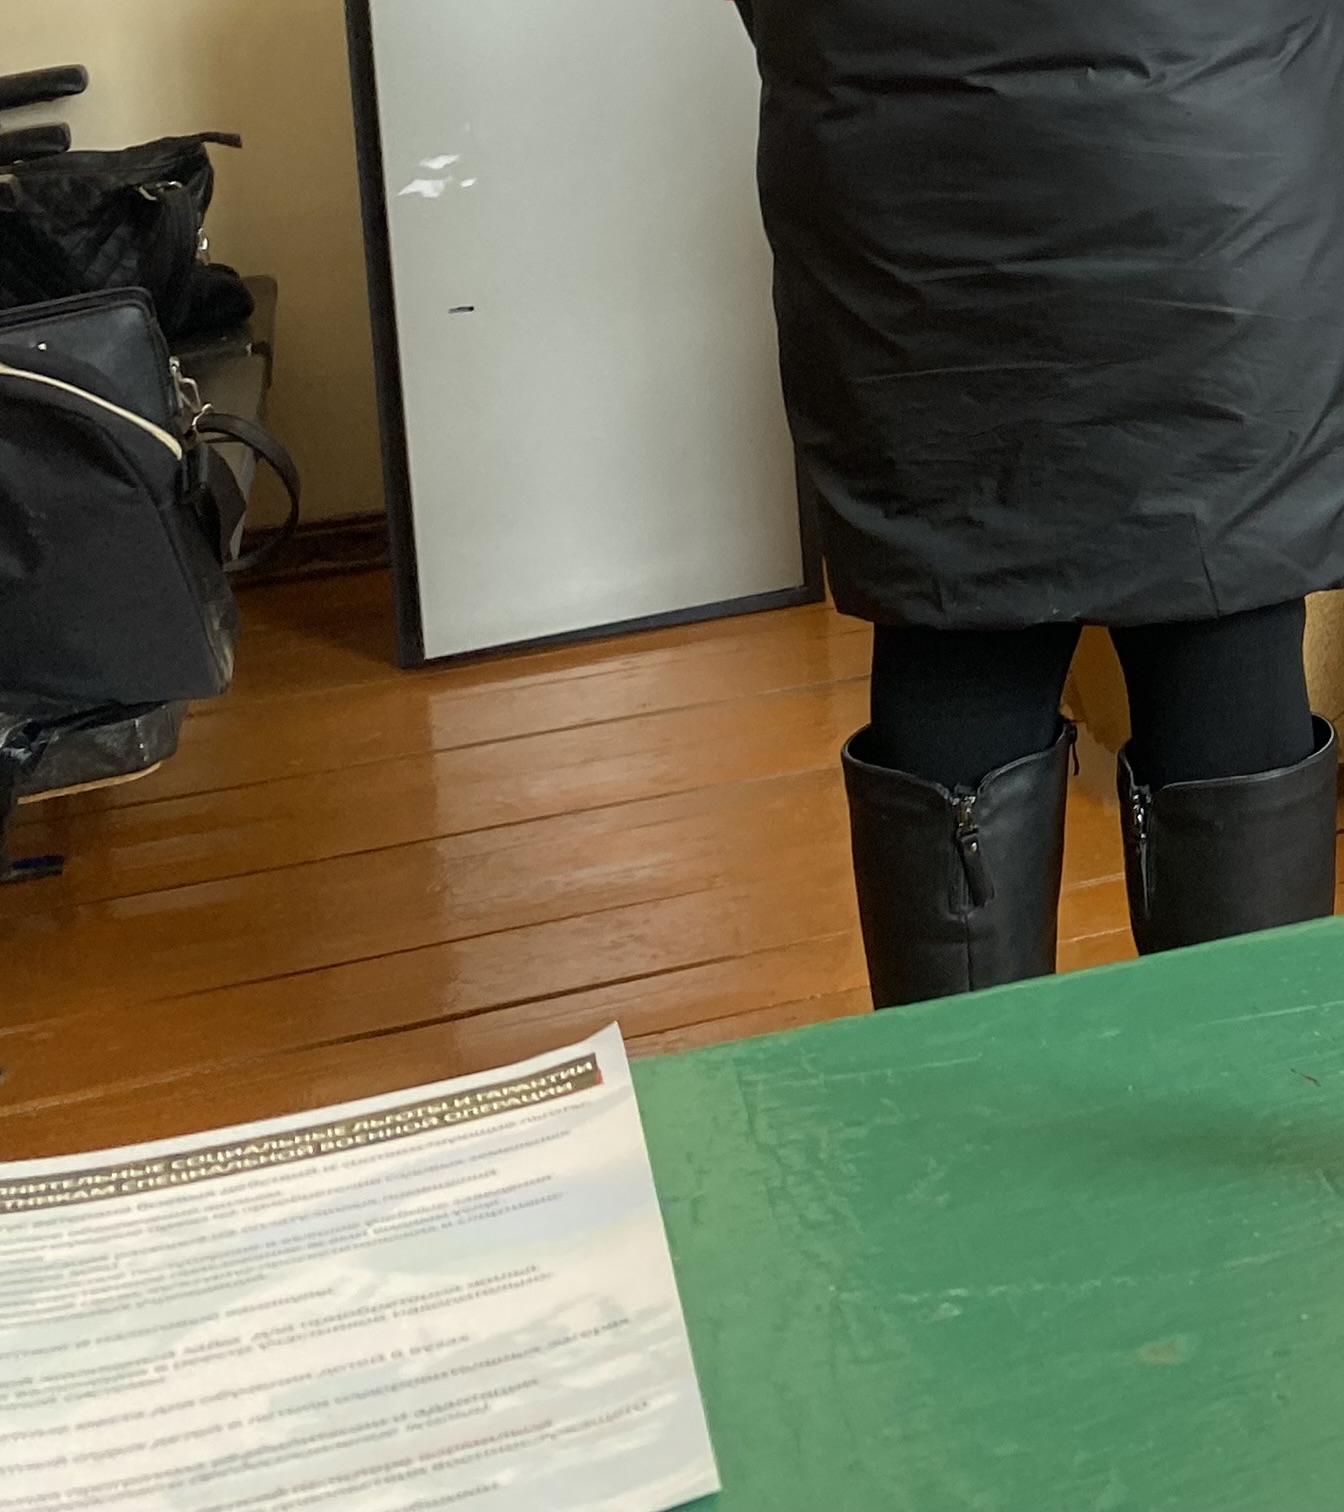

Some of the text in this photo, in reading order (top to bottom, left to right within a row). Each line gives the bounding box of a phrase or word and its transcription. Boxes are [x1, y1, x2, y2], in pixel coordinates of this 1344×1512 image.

[121, 1144, 314, 1192] СПЕЦИАЛЬНОЙ
[320, 1116, 439, 1153] ВОЕННОЙ
[444, 1080, 574, 1124] ОПЕРАЦИИ
[171, 1124, 346, 1171] СОЦИАЛЬНЫЕ
[352, 1101, 448, 1134] ЛЬГОТЫ
[476, 1060, 594, 1102] ГАРАНТИИ
